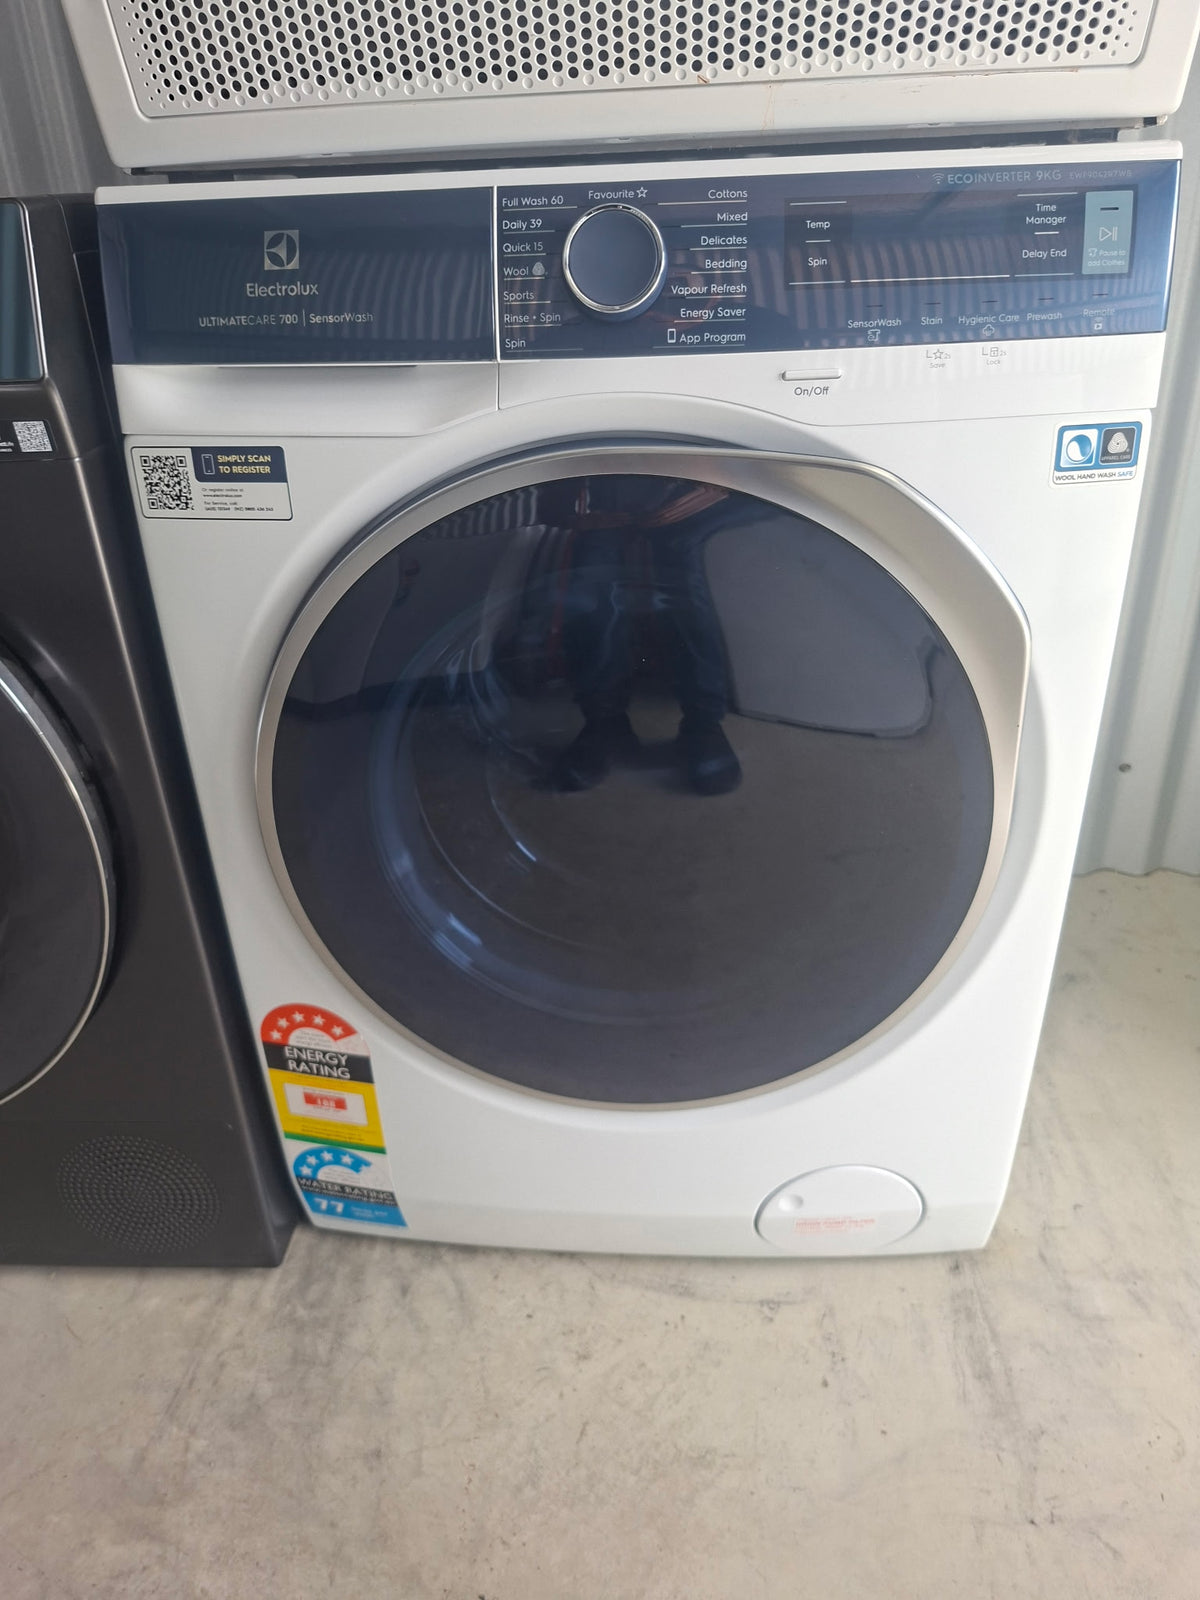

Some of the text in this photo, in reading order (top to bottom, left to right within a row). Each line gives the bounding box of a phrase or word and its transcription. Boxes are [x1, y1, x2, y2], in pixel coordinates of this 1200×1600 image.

[948, 171, 1031, 184] ECOINVERTER
[1036, 170, 1061, 181] 9KG
[588, 189, 634, 199] Favourite
[708, 189, 748, 199] Cottons
[502, 195, 563, 207] Full Wash 60
[1036, 203, 1057, 212] Time
[717, 212, 748, 221] Mixed
[1026, 215, 1067, 225] Manager
[502, 218, 542, 231] Daily 39
[806, 220, 831, 230] Temp
[701, 235, 748, 246] Delicates
[503, 242, 544, 252] Quick 15
[1022, 248, 1067, 260] Delay End
[705, 258, 747, 269] Bedding
[808, 257, 828, 267] Spin
[503, 266, 529, 276] Wool
[246, 281, 319, 297] Electrolux
[671, 283, 747, 296] Vapour Refresh
[503, 291, 535, 301] Sports
[504, 312, 561, 323] Rinse Spin
[680, 307, 746, 319] Energy Saver
[1026, 312, 1063, 321] Prewash
[198, 312, 374, 327] ULTIMATECARE 700 SensorWash
[847, 318, 902, 328] SensorWash
[920, 317, 943, 326] Stain
[958, 313, 1020, 325] Hygienic Care
[505, 338, 526, 349] Spin
[680, 333, 746, 344] App Program
[794, 386, 830, 397] On/Off
[217, 454, 271, 463] SIMPLY SCAN
[219, 465, 271, 474] TO REGISTER
[284, 1045, 348, 1066] ENERGY
[288, 1059, 350, 1080] RATING
[314, 1196, 344, 1213] 77
